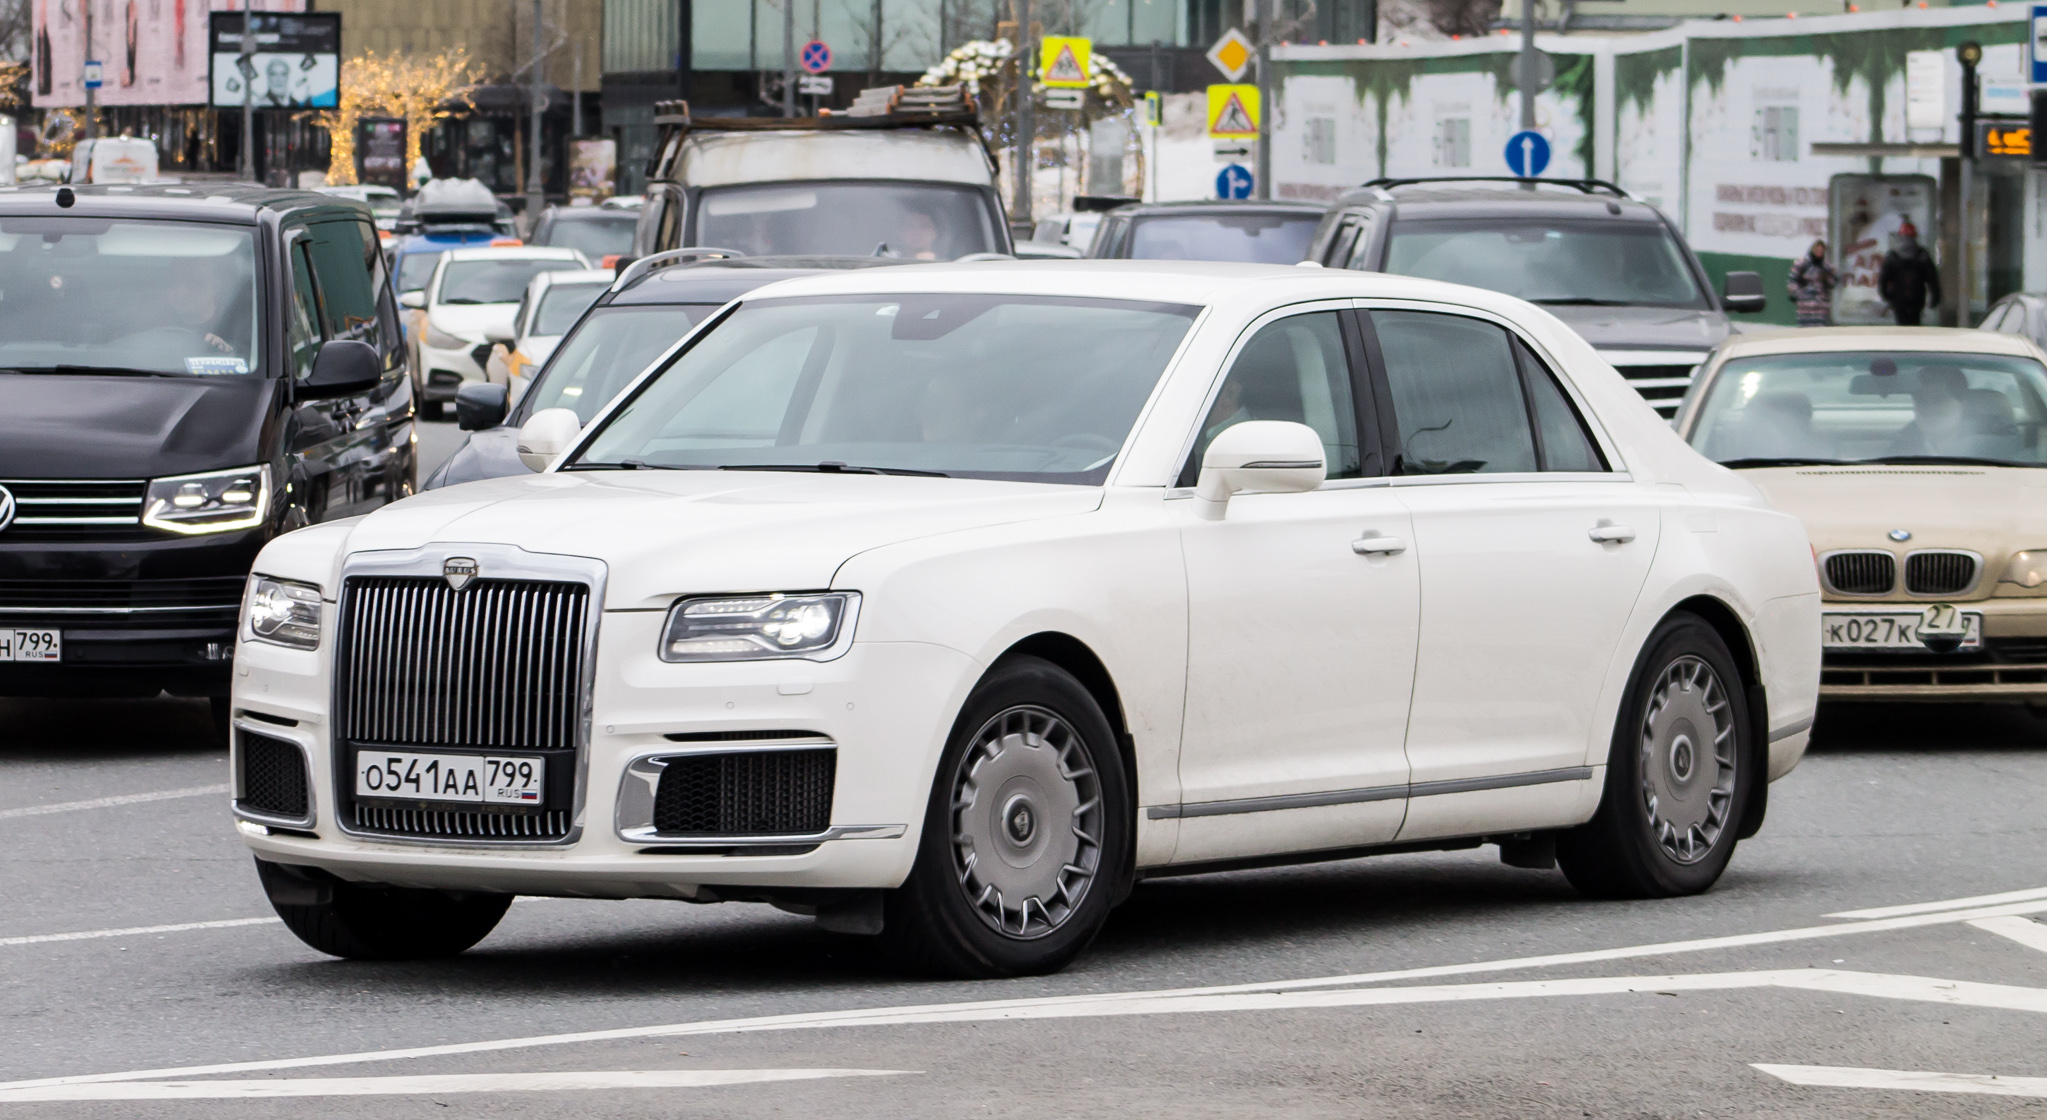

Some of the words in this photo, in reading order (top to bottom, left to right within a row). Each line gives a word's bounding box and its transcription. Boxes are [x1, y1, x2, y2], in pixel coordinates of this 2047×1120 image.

[16, 632, 53, 650] 799
[25, 650, 43, 658] RUS
[487, 760, 533, 788] 799
[497, 788, 520, 799] RUS
